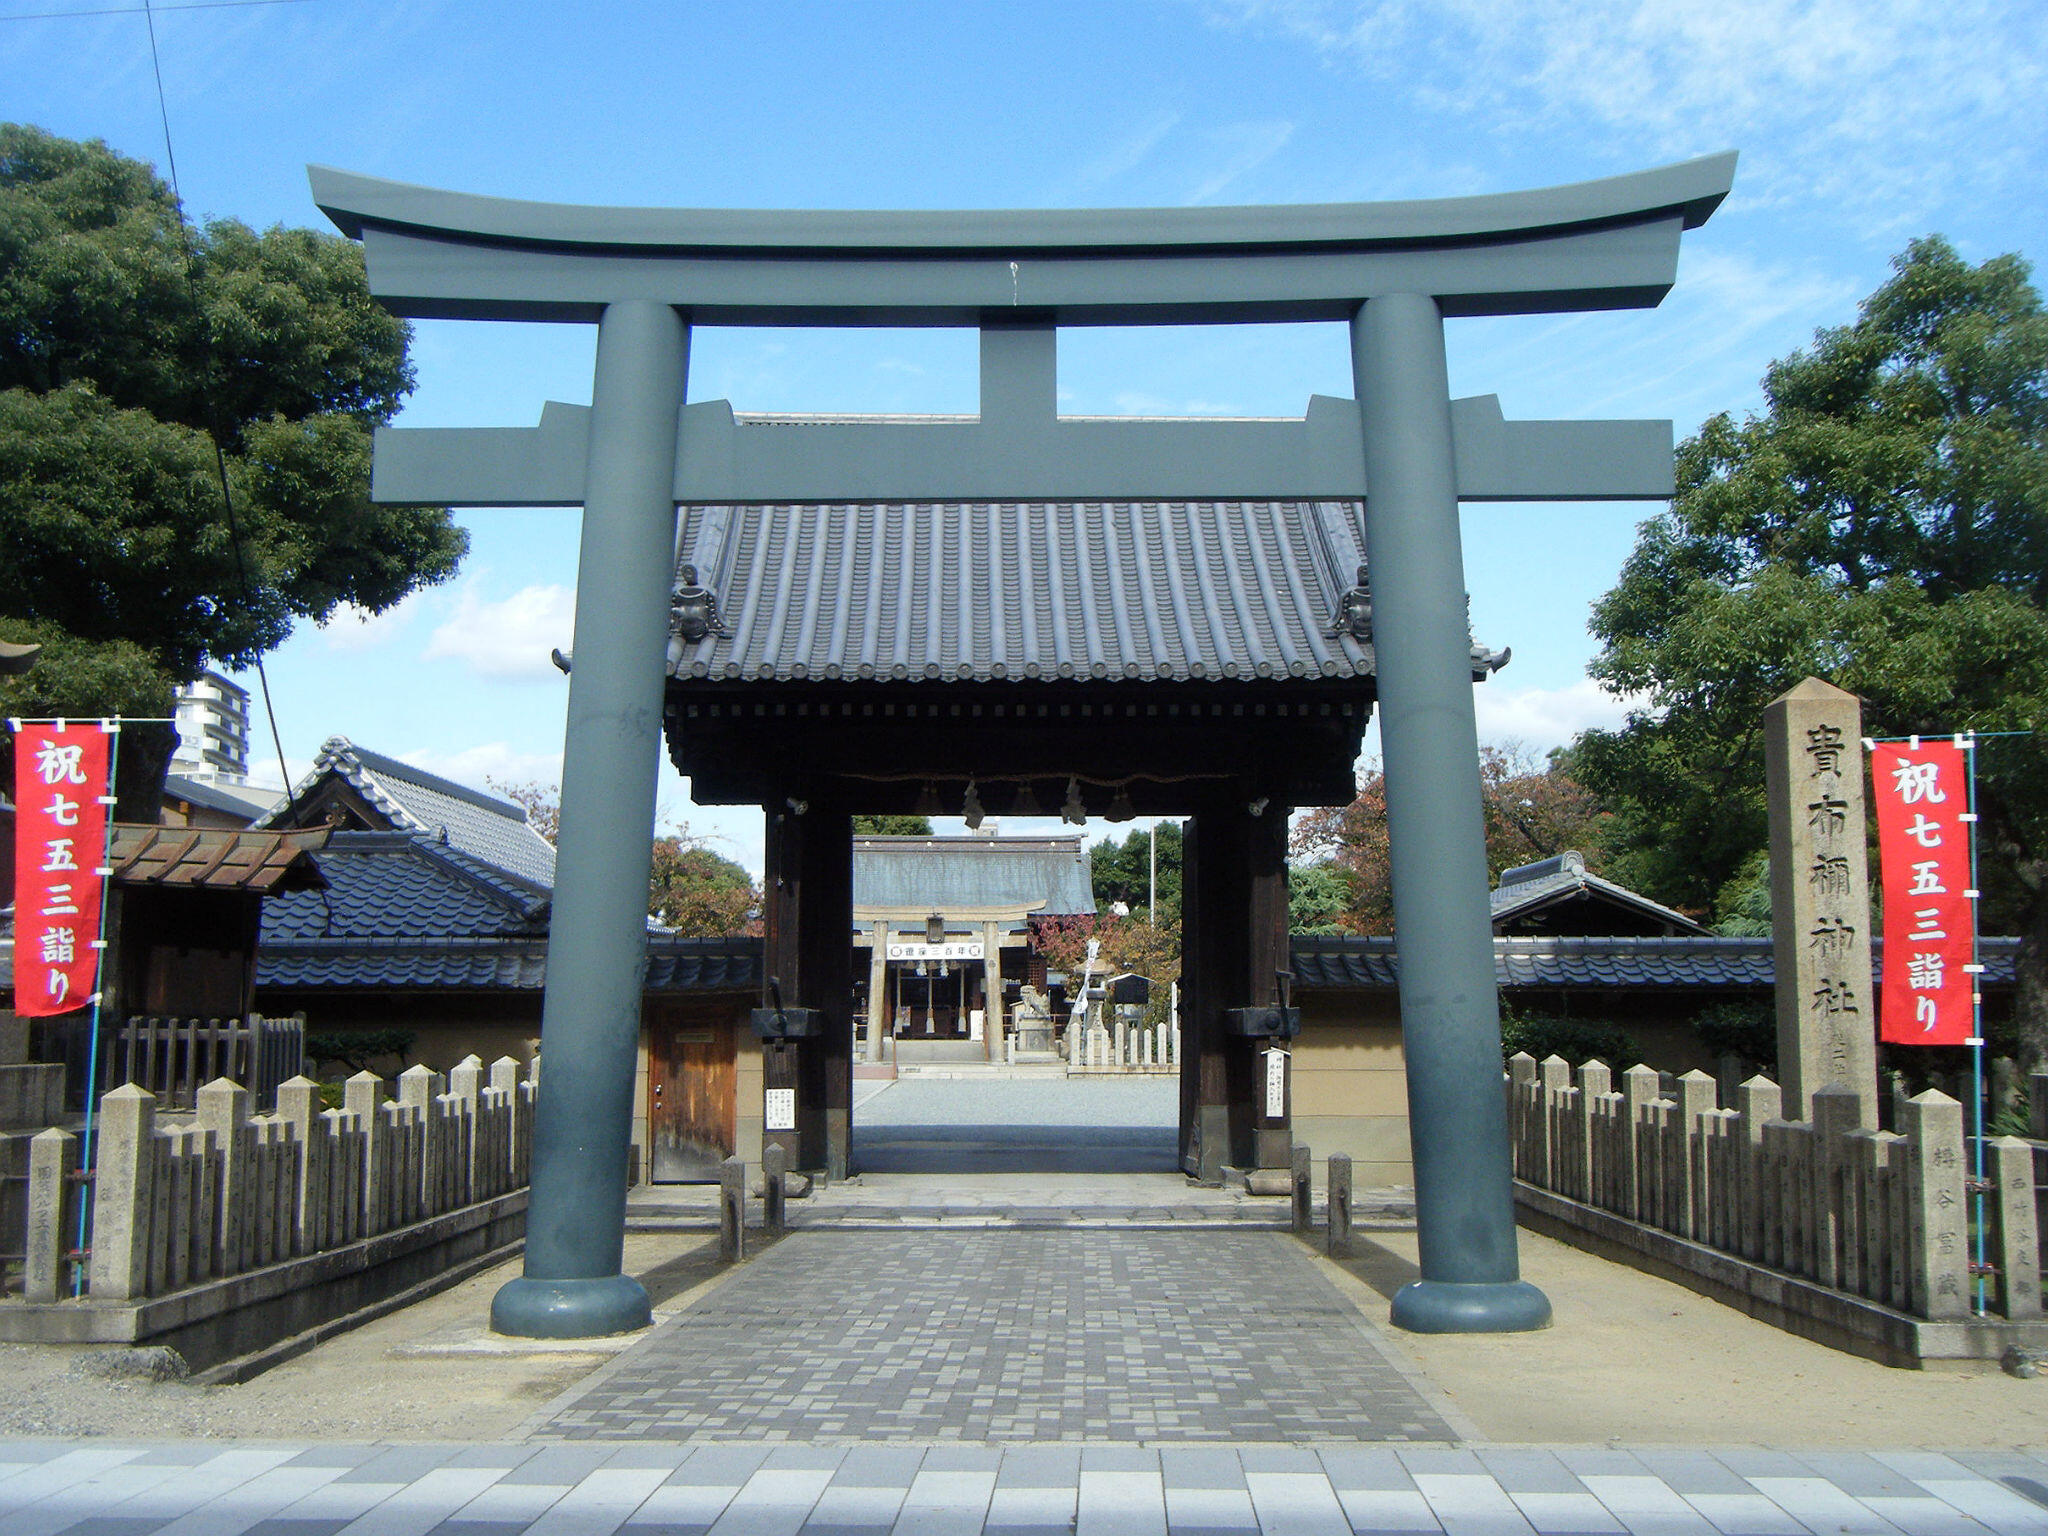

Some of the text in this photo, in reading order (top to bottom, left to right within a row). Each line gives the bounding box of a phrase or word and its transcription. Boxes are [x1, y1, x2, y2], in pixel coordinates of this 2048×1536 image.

[35, 738, 88, 1005] 祝七五三詣り
[1891, 757, 1947, 1033] 祝七五三詣り
